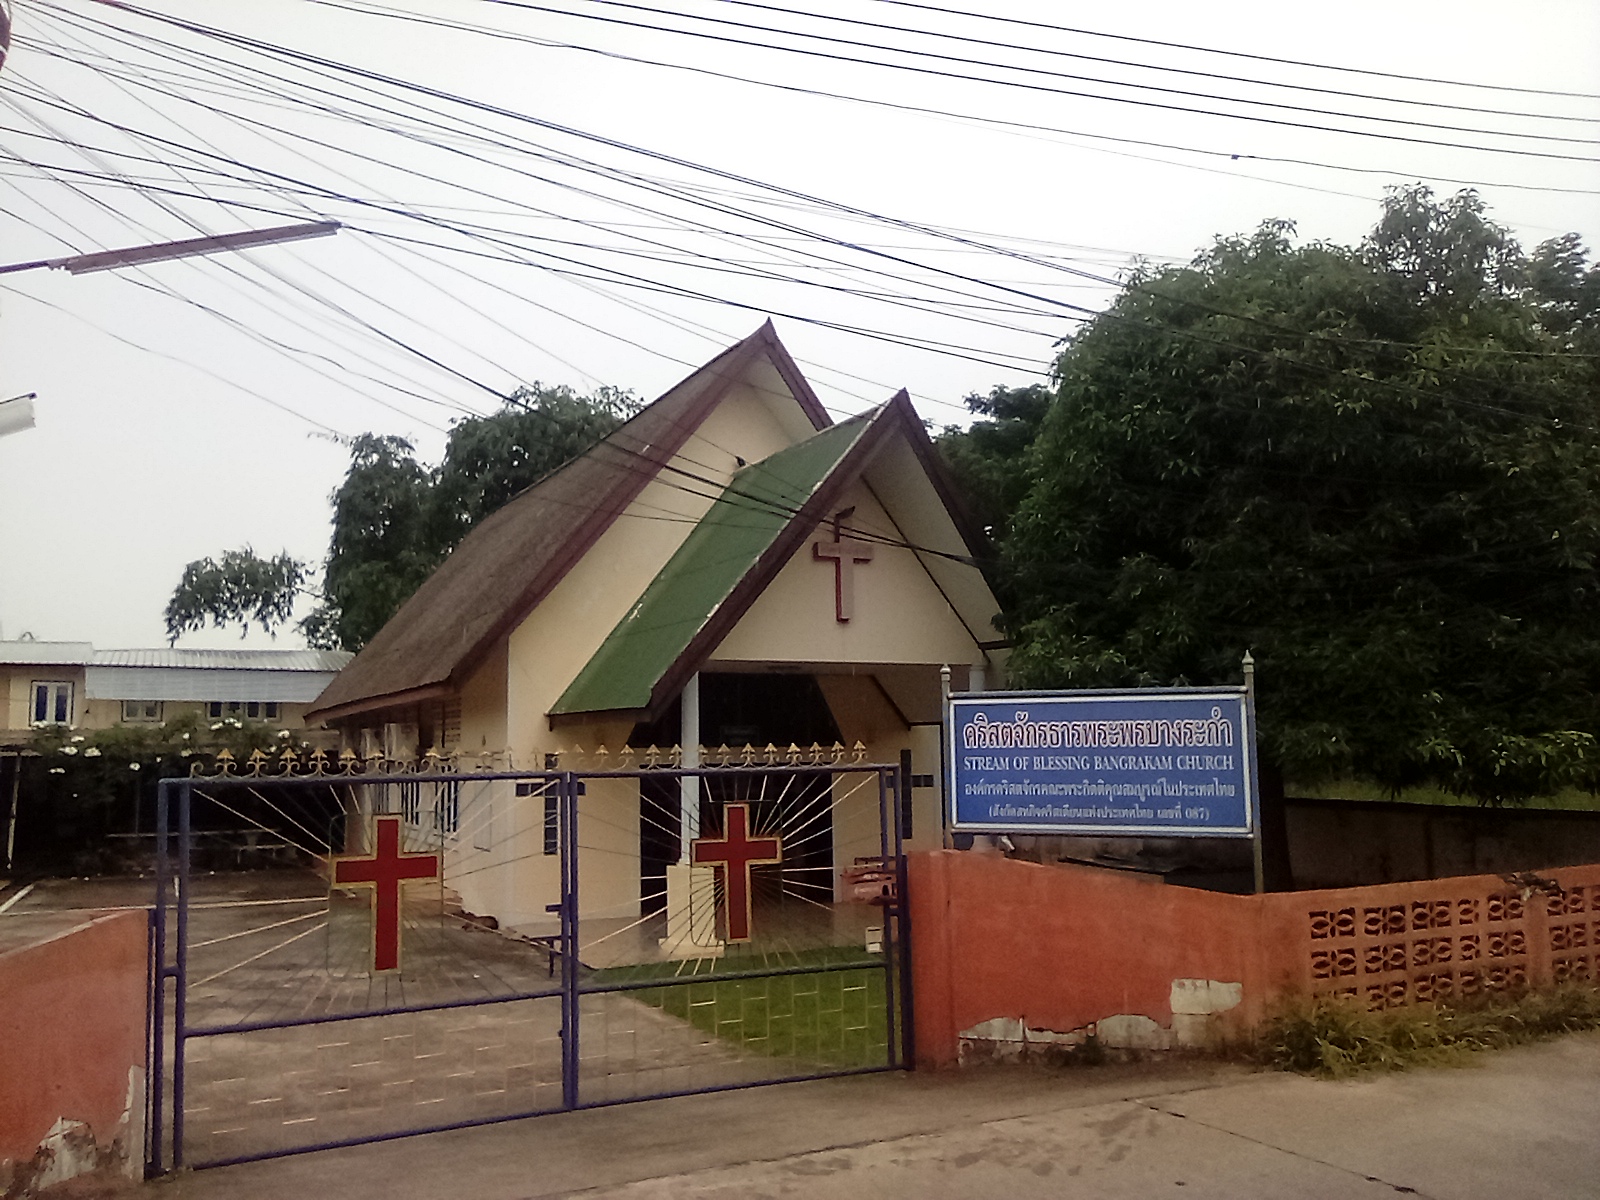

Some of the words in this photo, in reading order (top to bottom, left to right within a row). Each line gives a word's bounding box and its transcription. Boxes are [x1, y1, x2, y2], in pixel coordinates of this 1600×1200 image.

[963, 706, 1233, 748] คริสตจักรธารพระพรบางระกำ
[964, 756, 1009, 771] STREAM
[1013, 756, 1030, 771] OF
[1033, 755, 1090, 771] BLESSING
[1094, 755, 1173, 771] BANGRAKAM
[1176, 755, 1234, 771] CHURCH
